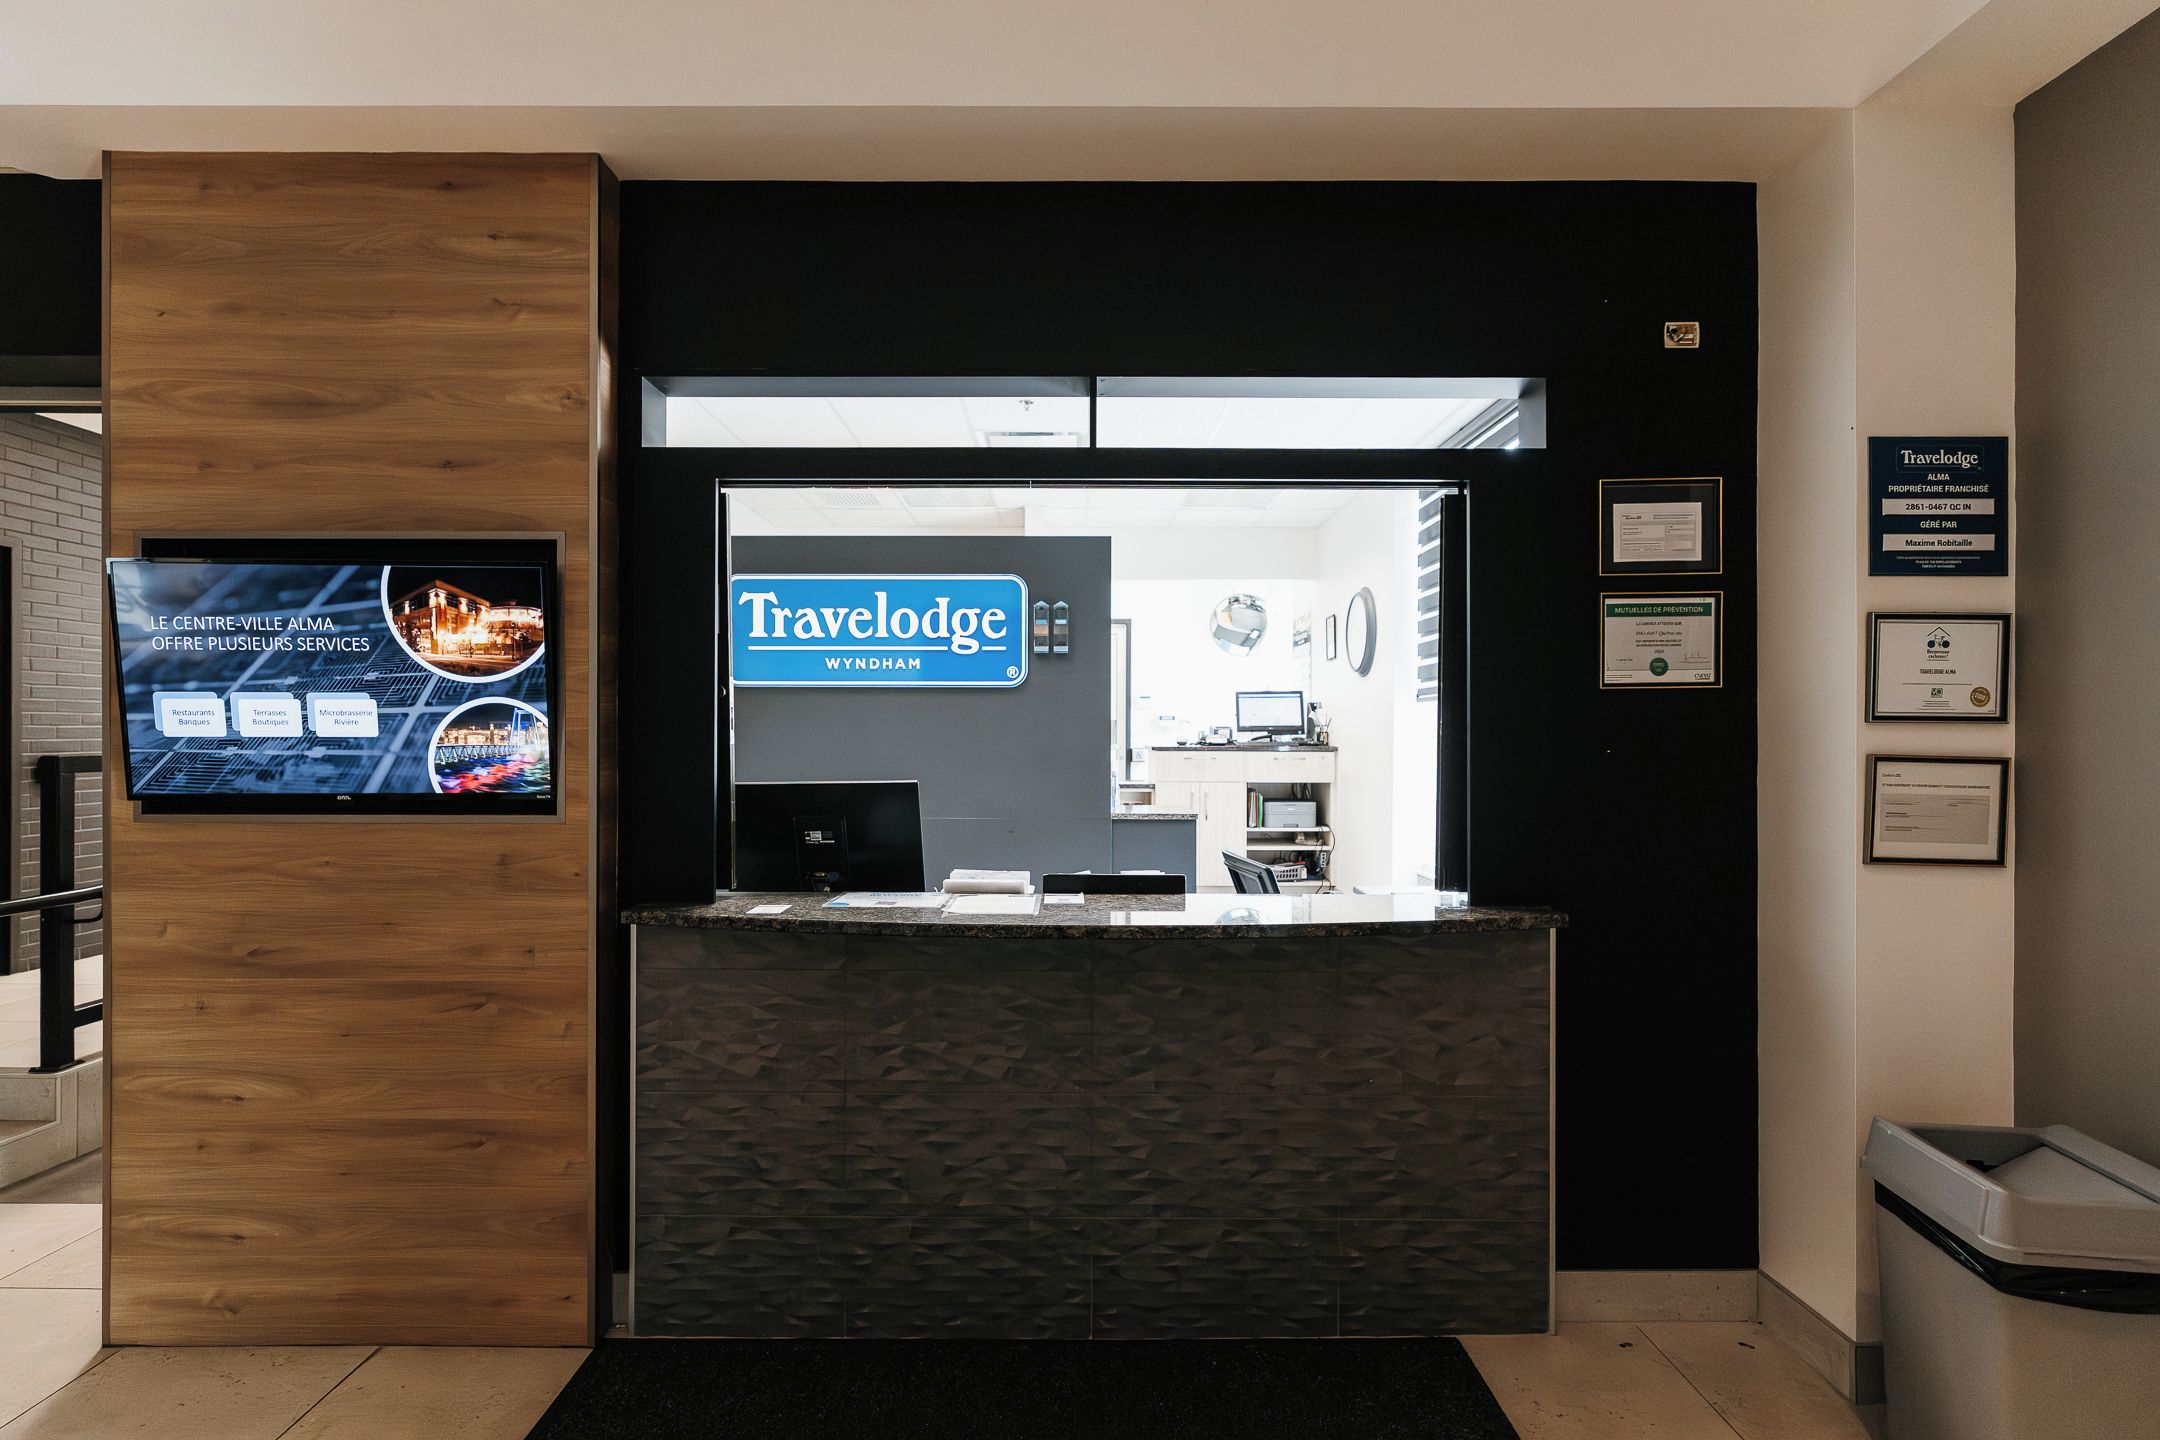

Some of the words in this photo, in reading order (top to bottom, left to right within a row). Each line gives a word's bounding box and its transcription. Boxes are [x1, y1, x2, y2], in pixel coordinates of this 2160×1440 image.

[1901, 449, 1979, 469] Travelodge
[1927, 473, 1950, 481] ALMA
[1888, 484, 1943, 493] PROPRIÉTAIRE
[1945, 484, 1989, 493] FRANCHISÉ
[1949, 503, 1961, 511] QC
[1962, 503, 1971, 511] IN
[1920, 520, 1940, 528] GÉRÉ
[1905, 539, 1935, 547] Maxime
[1937, 539, 1973, 547] Robitaille
[151, 616, 168, 630] LE
[173, 616, 283, 631] CENTRE-VILLE
[287, 617, 335, 631] ALMA
[738, 591, 1007, 655] Travelodge
[152, 636, 204, 650] OFFRE
[208, 636, 293, 651] PLUSIEURS
[297, 637, 370, 651] SERVICES
[825, 657, 921, 670] WYNDHAM
[172, 709, 215, 717] Restaurants
[253, 709, 287, 717] Terrasses
[319, 709, 374, 717] Microbrasserie
[178, 718, 211, 727] Banques
[252, 718, 289, 727] Boutiques
[334, 718, 359, 726] Rivière
